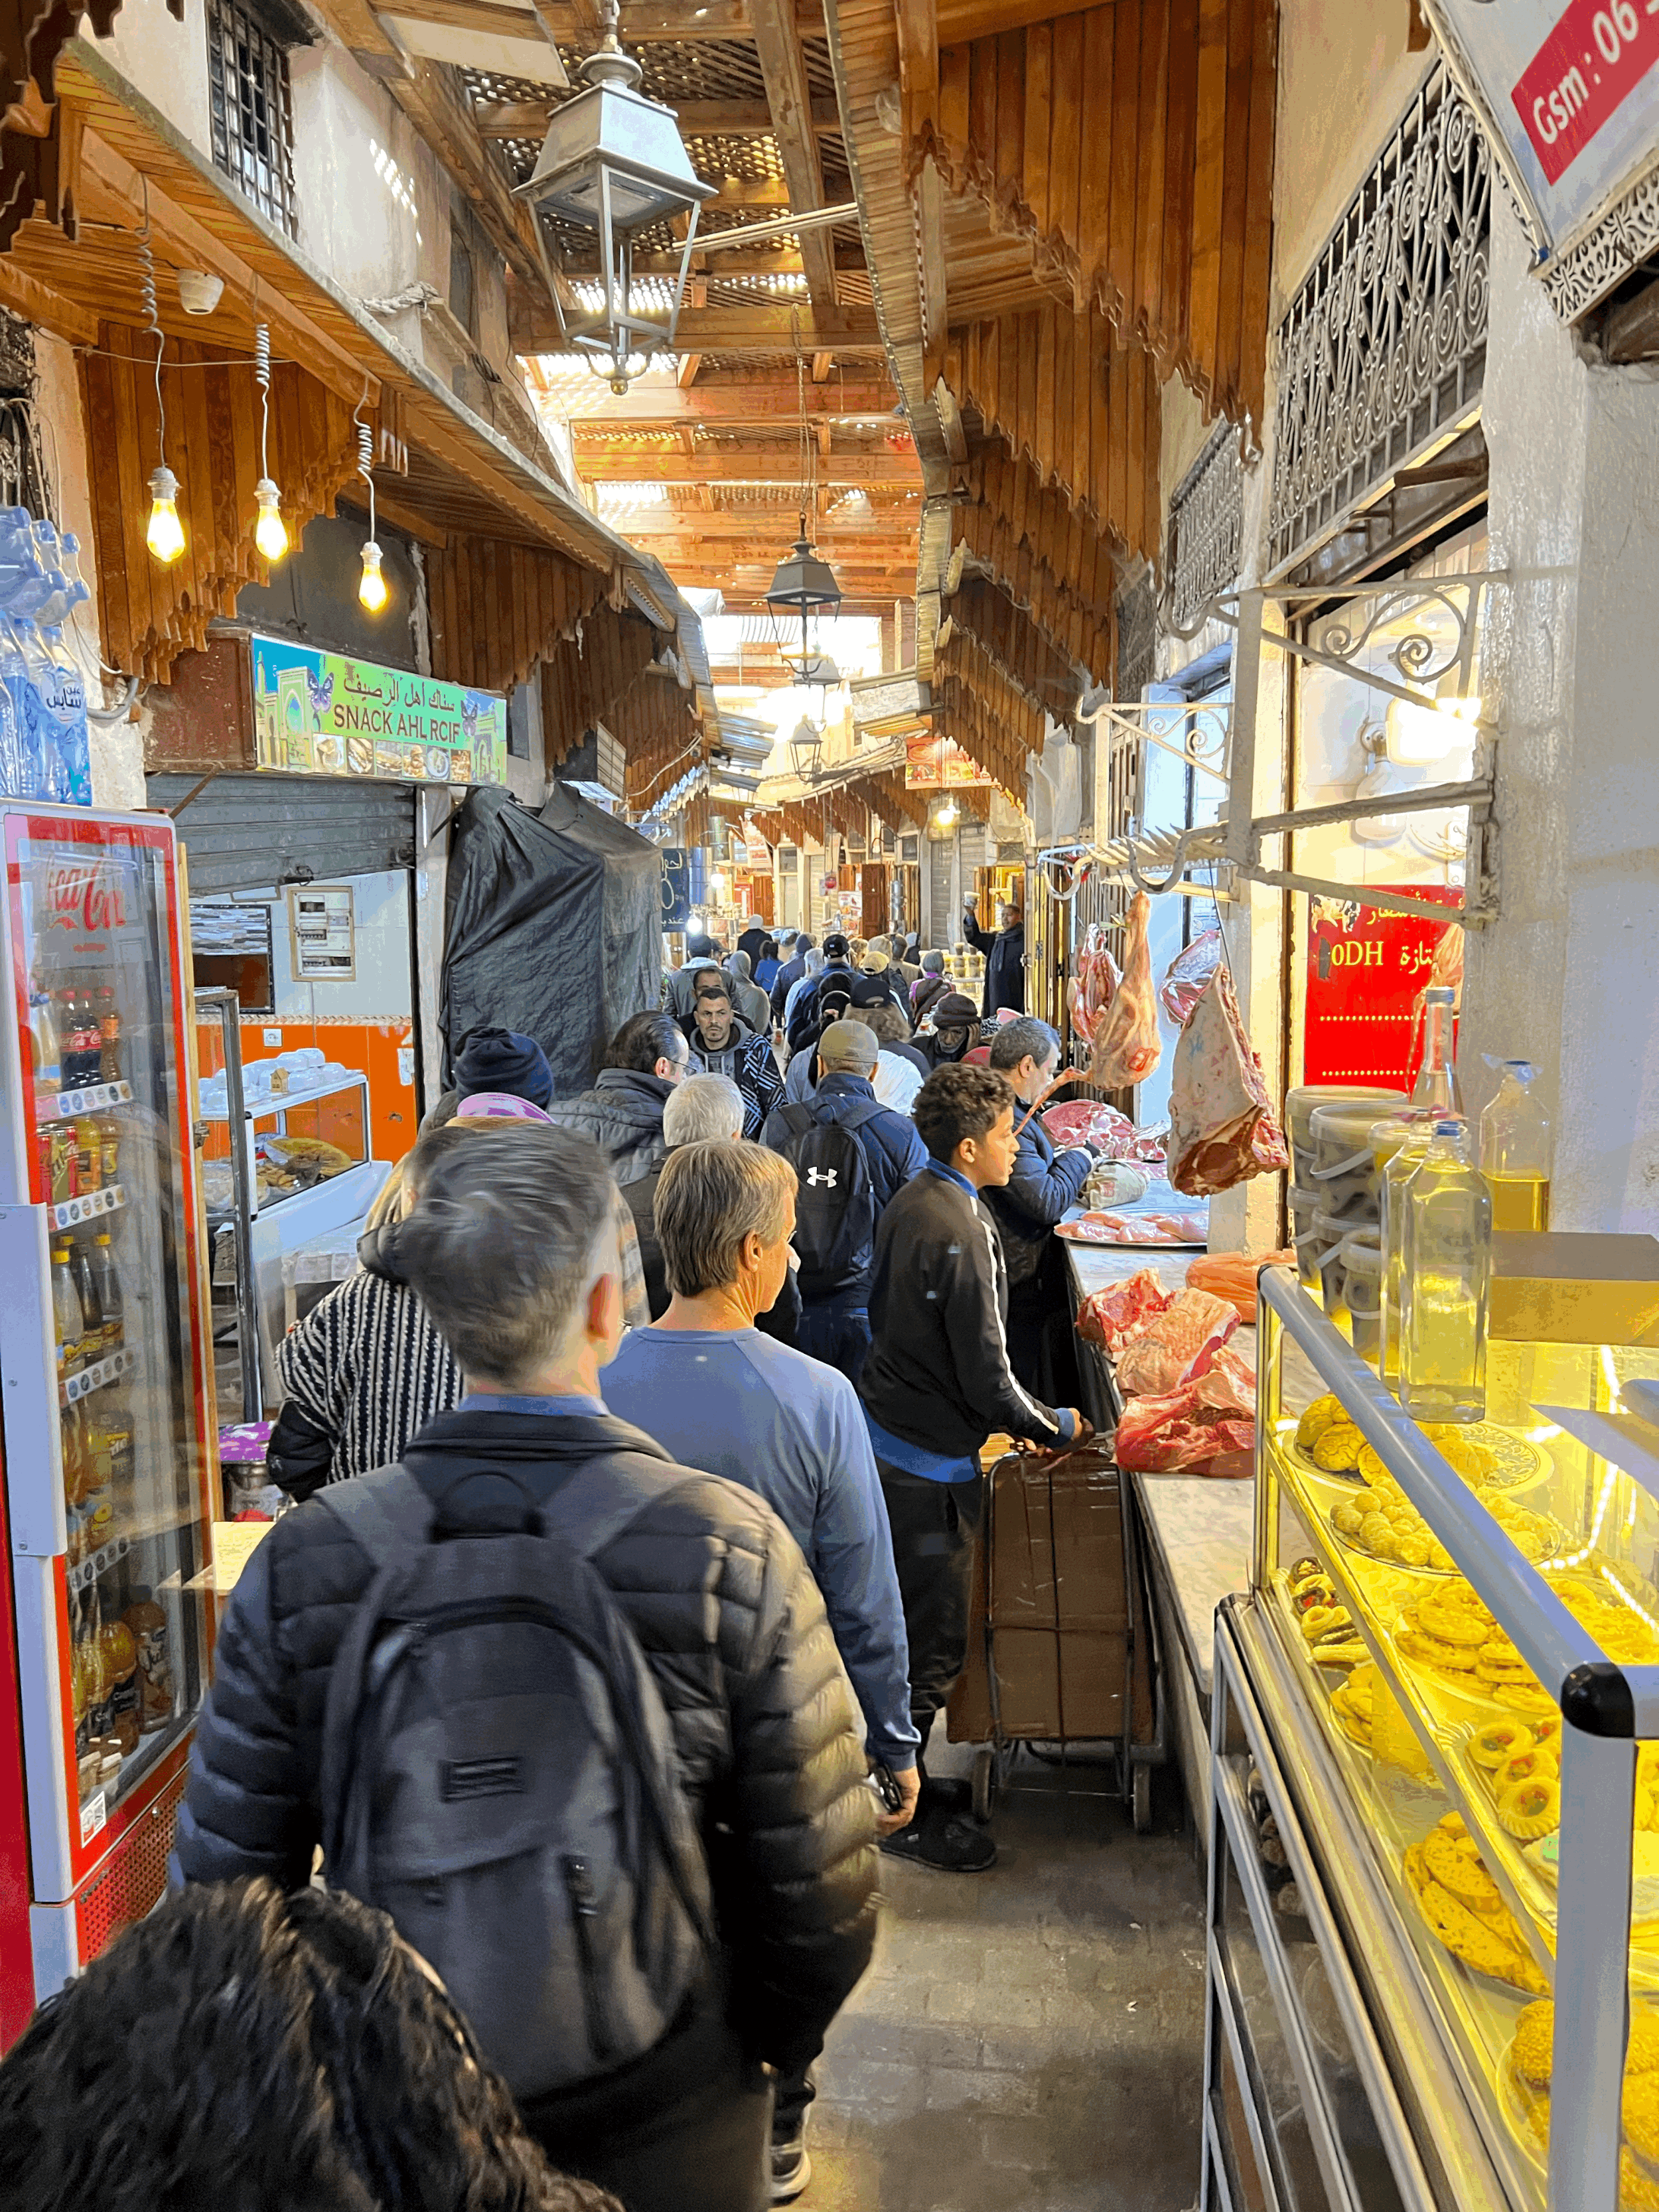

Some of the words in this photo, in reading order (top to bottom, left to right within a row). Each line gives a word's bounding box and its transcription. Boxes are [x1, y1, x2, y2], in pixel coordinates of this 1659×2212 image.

[1534, 66, 1589, 144] Gsm
[334, 703, 393, 735] SNACK
[396, 712, 427, 741] AHL
[429, 718, 461, 744] RCIF
[1400, 940, 1433, 974] تازة
